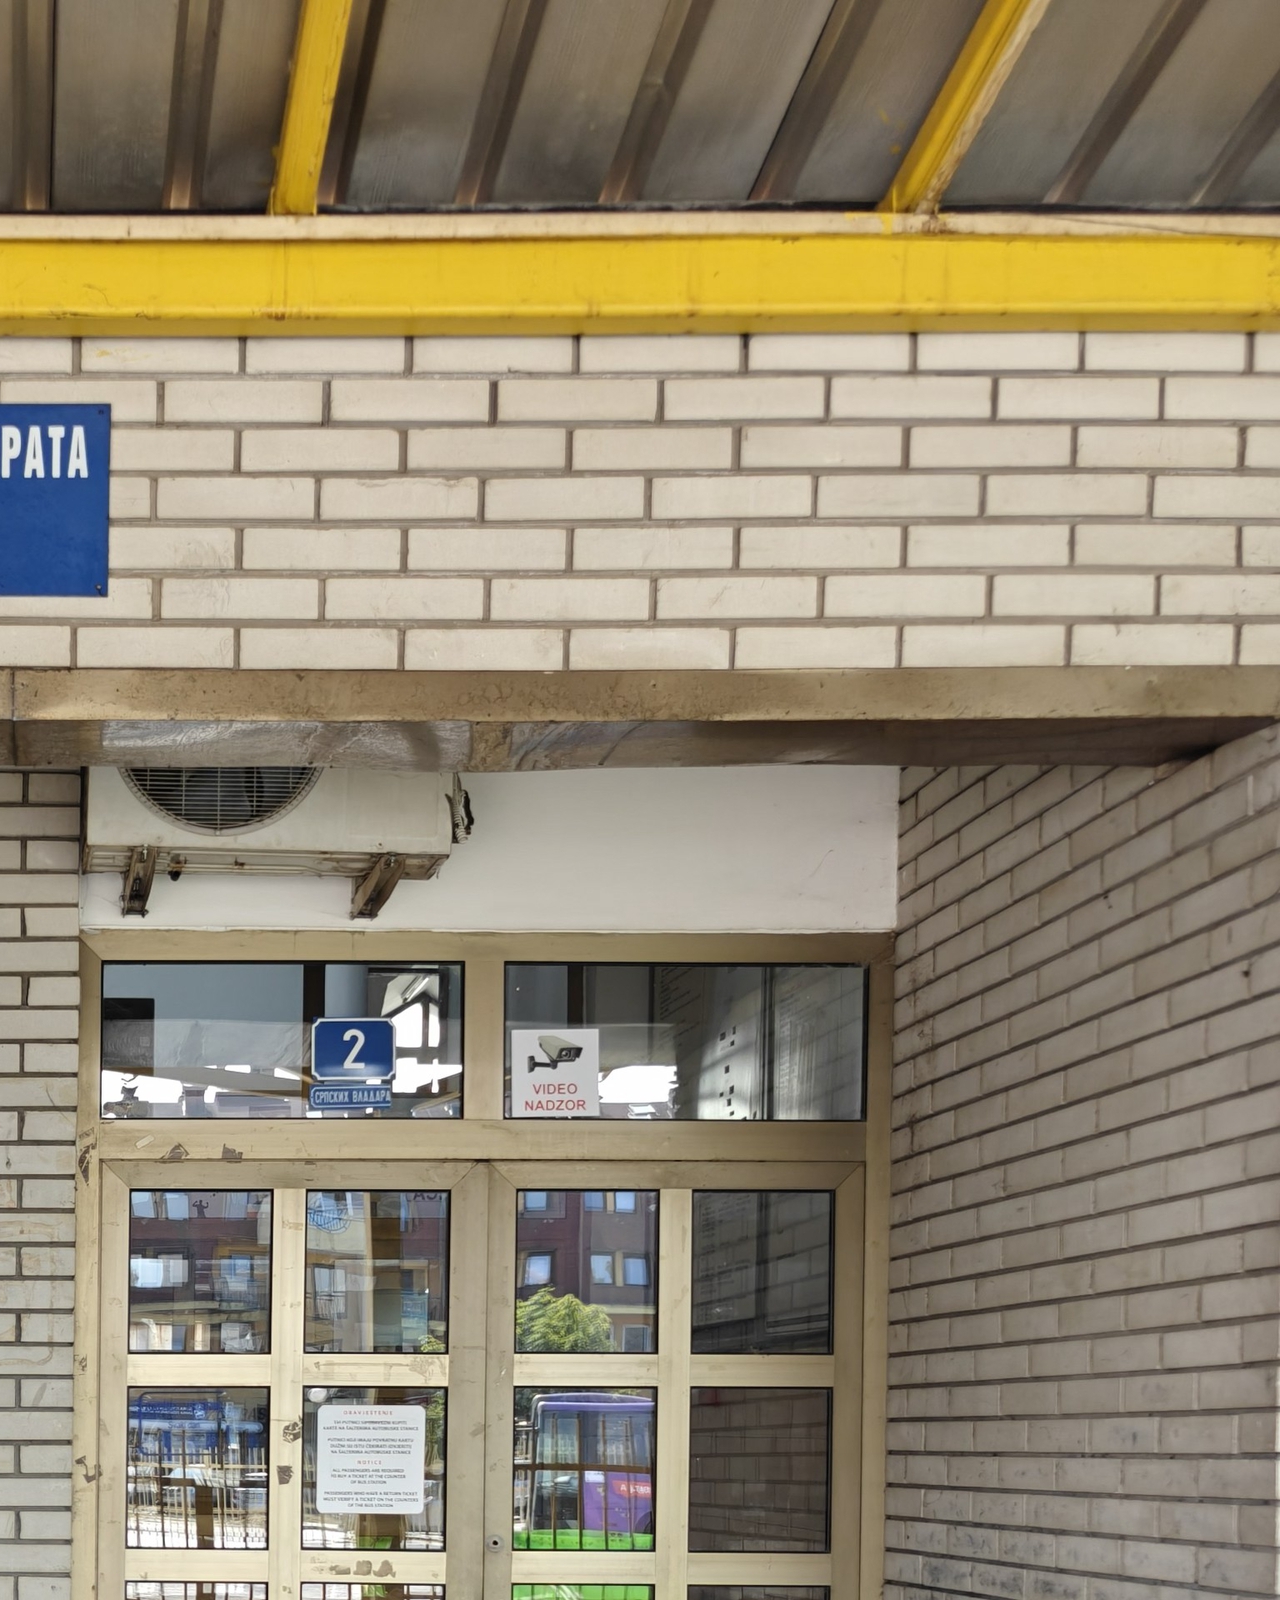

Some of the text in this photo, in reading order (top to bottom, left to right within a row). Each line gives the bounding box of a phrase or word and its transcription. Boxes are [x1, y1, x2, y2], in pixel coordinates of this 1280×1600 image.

[342, 1028, 366, 1069] 2
[532, 1083, 578, 1095] VIDEO
[315, 1091, 348, 1103] СРПСКИХ
[524, 1099, 587, 1112] NADZOR
